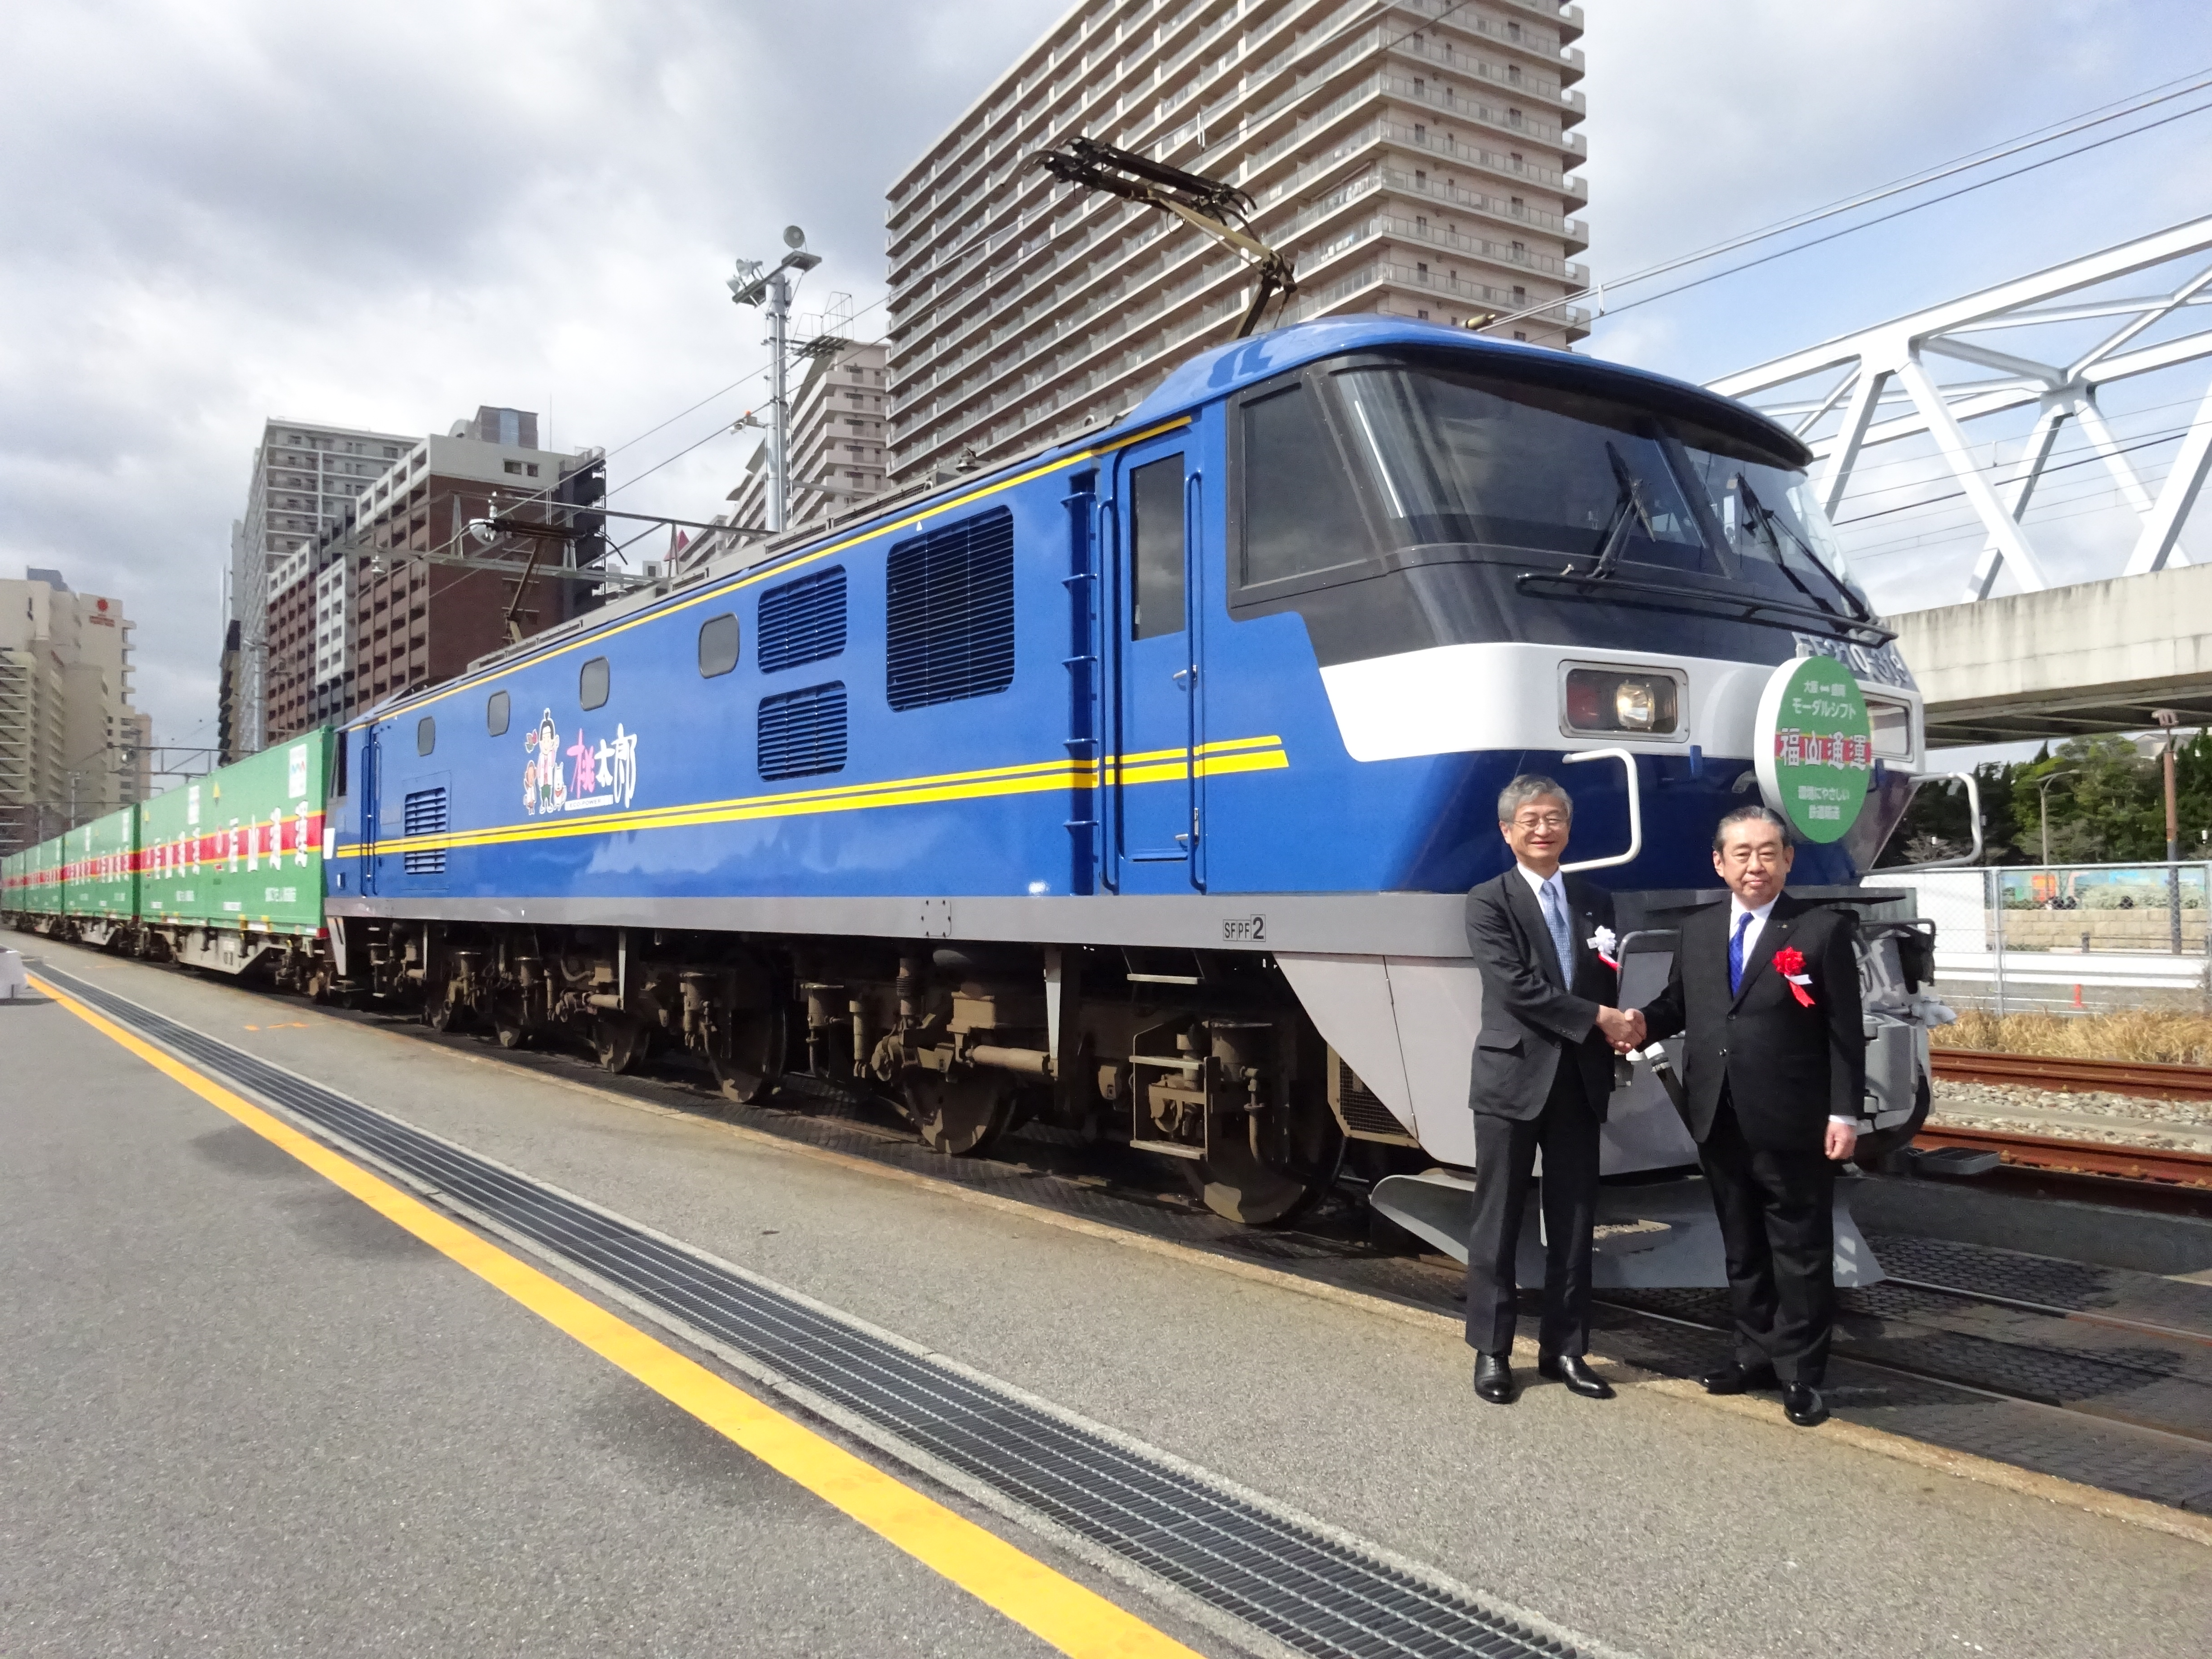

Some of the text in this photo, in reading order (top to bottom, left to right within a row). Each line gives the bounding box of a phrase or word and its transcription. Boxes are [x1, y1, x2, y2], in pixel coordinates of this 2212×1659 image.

[1792, 698, 1856, 720] モーダルシフト
[567, 723, 637, 808] 桃太郎
[1780, 727, 1867, 771] 福山通運
[570, 799, 601, 808] ECO-POWER
